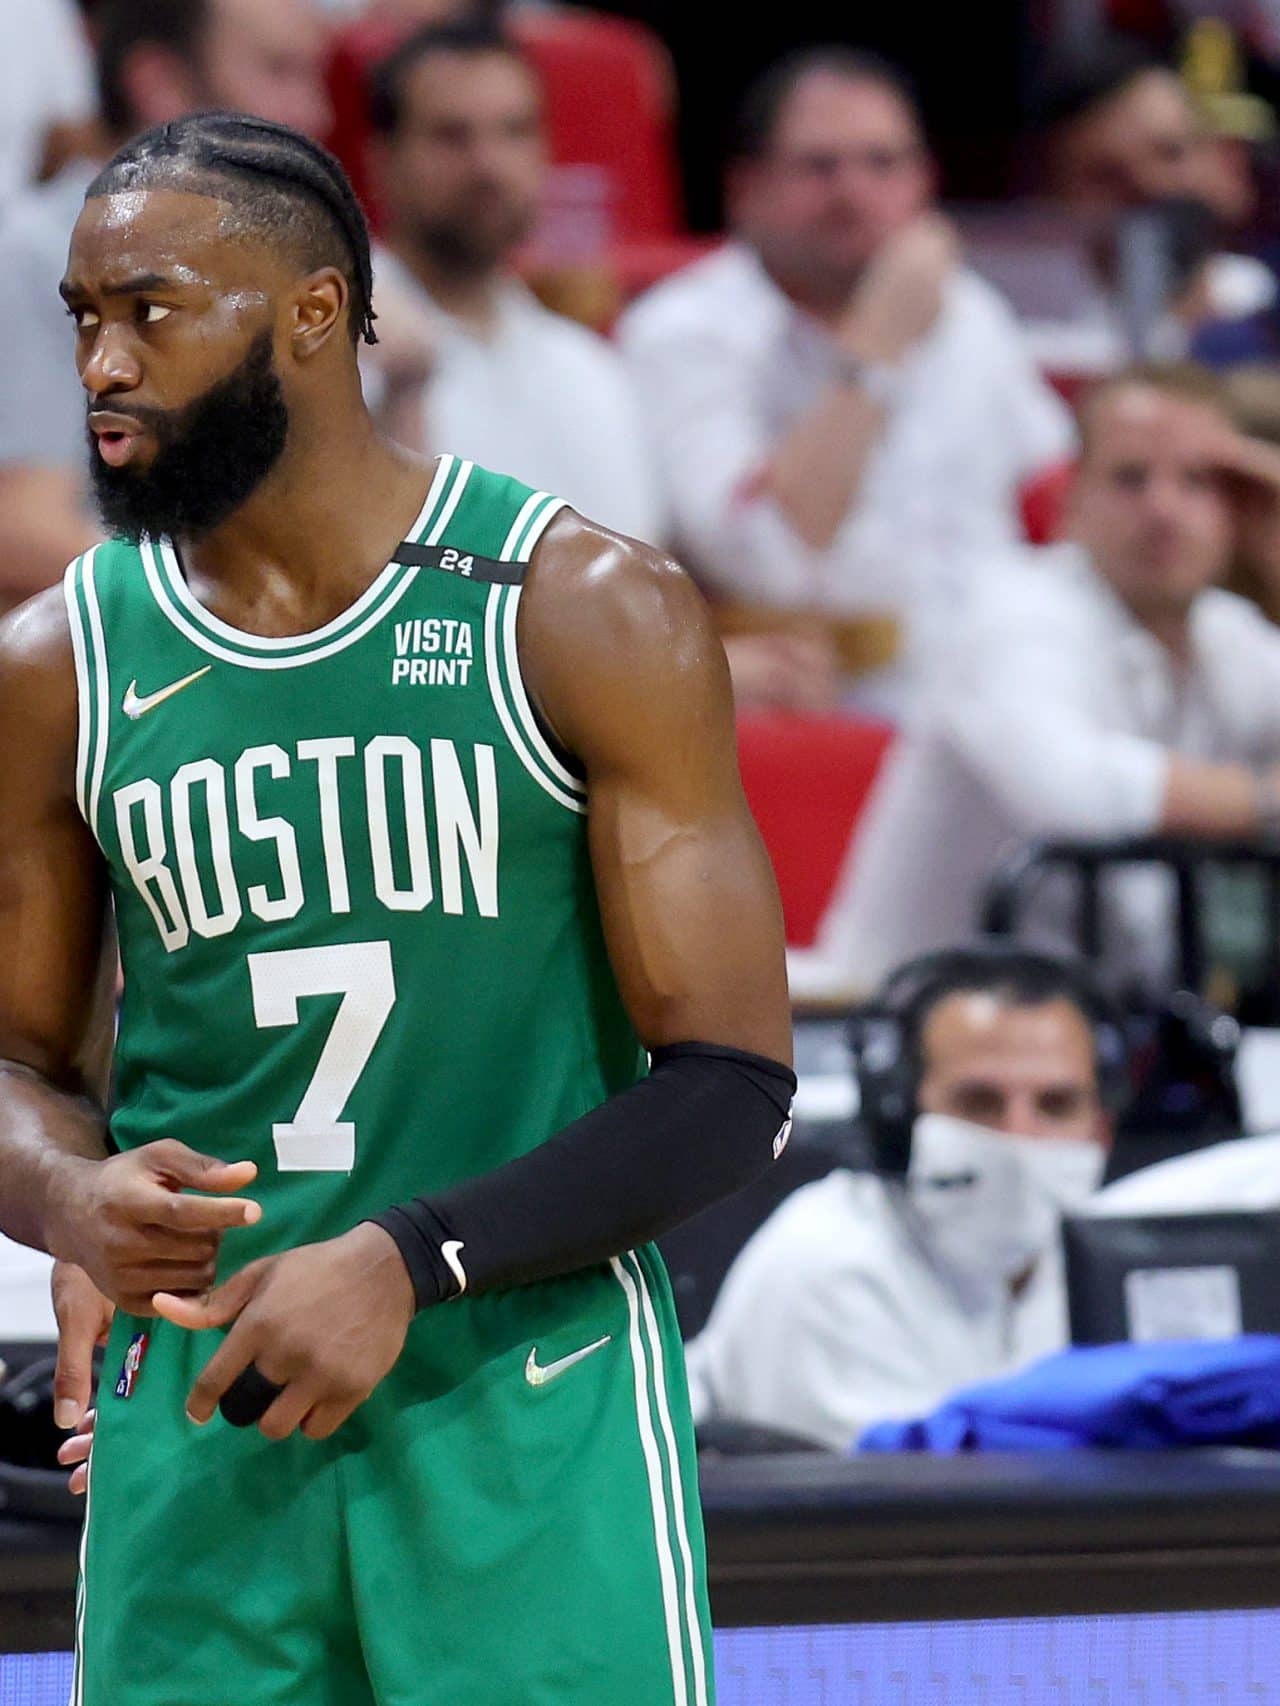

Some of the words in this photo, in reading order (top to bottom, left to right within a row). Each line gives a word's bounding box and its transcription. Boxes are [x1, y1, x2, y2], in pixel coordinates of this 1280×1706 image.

[439, 548, 474, 577] 24
[394, 619, 473, 658] VISTA
[391, 658, 473, 686] PRINT
[112, 735, 499, 953] BOSTON
[246, 940, 397, 1177] 7
